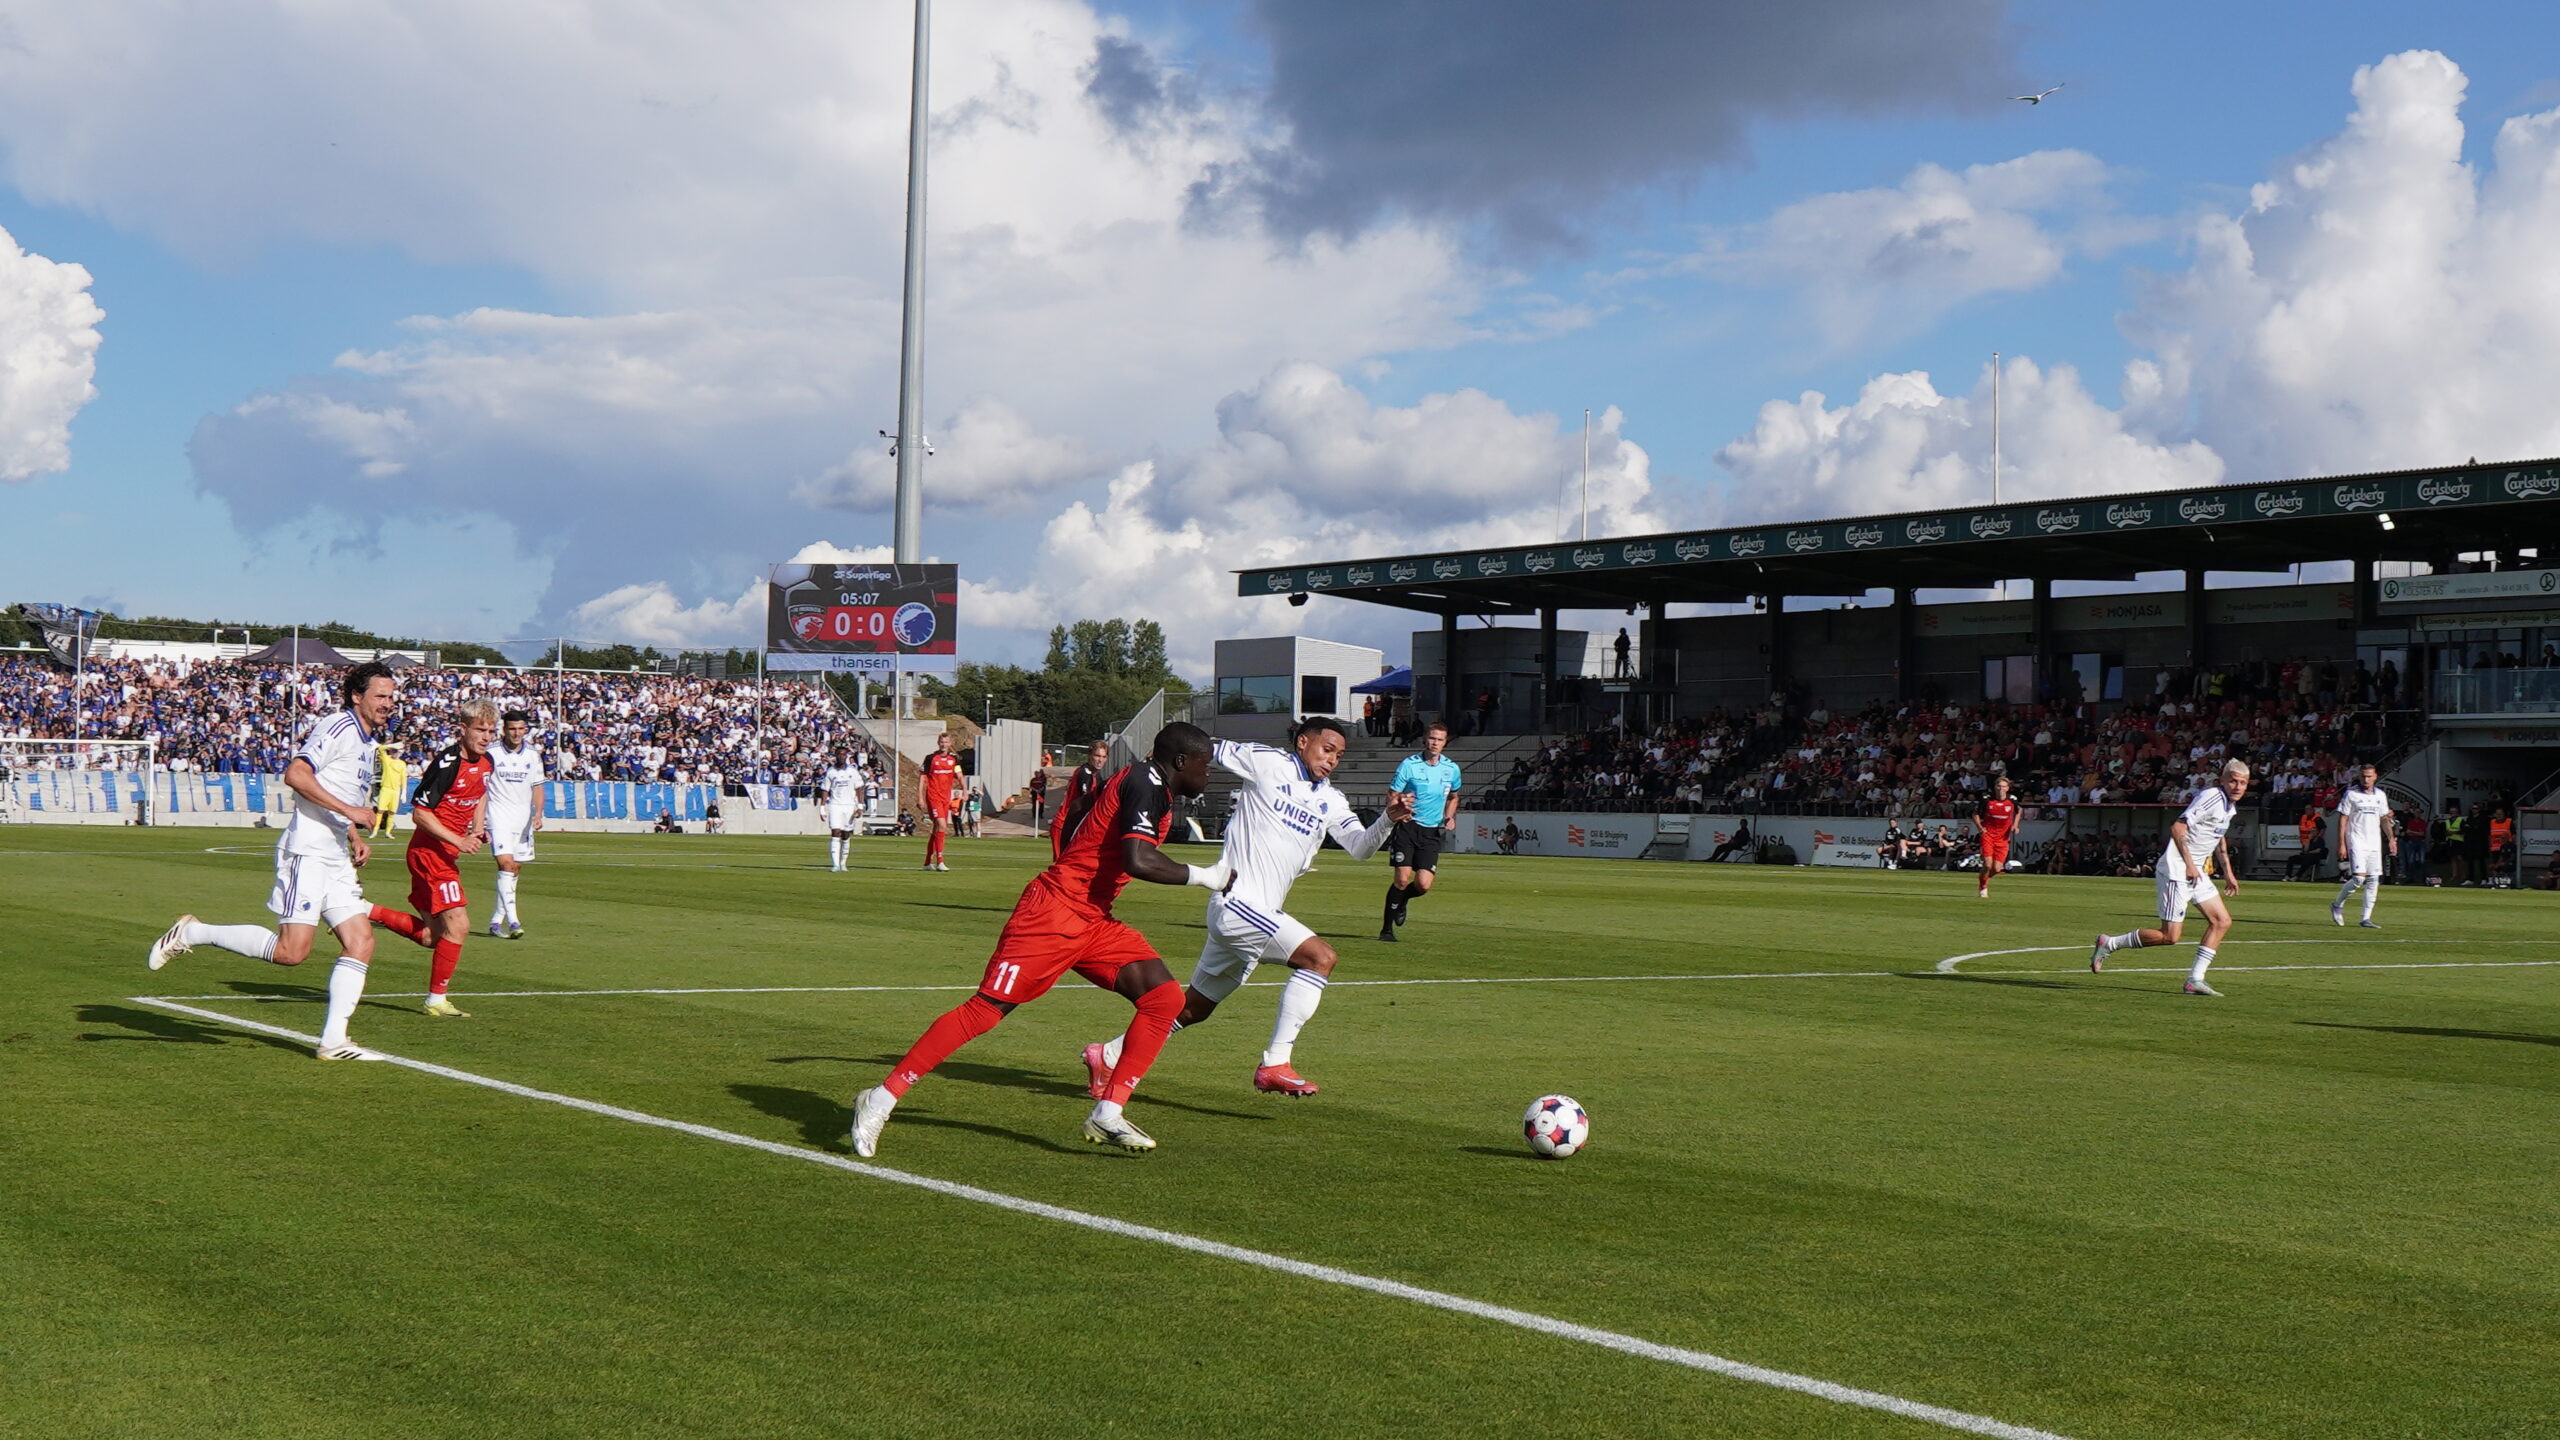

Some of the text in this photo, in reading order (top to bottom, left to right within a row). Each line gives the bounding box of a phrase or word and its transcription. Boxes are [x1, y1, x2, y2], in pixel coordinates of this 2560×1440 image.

[2417, 477, 2471, 502] Carlsberg
[2504, 470, 2560, 496] Carlsberg
[2255, 490, 2304, 513] Carlsberg
[2334, 483, 2386, 507] Carlsberg
[2107, 502, 2152, 525] Carlsberg
[2179, 497, 2226, 519] Carlsberg
[1970, 514, 2012, 535] Carlsberg
[2037, 508, 2081, 529] Carlsberg
[1845, 524, 1884, 545] Carlsberg
[1906, 519, 1946, 540] Carlsberg
[1730, 534, 1766, 553] Carlsberg
[1786, 529, 1824, 549] Carlsberg
[1573, 548, 1605, 566] Carlsberg
[1623, 543, 1656, 562] Carlsberg
[1675, 539, 1711, 558] Carlsberg
[1433, 559, 1462, 577] Carlsberg
[1478, 556, 1508, 573] Carlsberg
[1525, 552, 1555, 570] Carlsberg
[846, 570, 891, 581] Superliga
[1307, 570, 1333, 586] Carlsberg
[1348, 567, 1374, 583] Carlsberg
[1389, 563, 1417, 580] Carlsberg
[1268, 573, 1293, 589] Carlsberg
[841, 592, 880, 605] 05:07
[2107, 604, 2162, 620] MONJASA
[832, 656, 890, 669] thansen
[2508, 731, 2560, 744] MONJASA
[500, 771, 528, 779] UNIBET
[1273, 799, 1323, 830] UNIBET
[1590, 840, 1604, 848] Since
[1604, 831, 1629, 840] Shipping
[1841, 836, 1850, 845] Oil
[439, 881, 460, 903] 10
[993, 961, 1021, 994] 11
